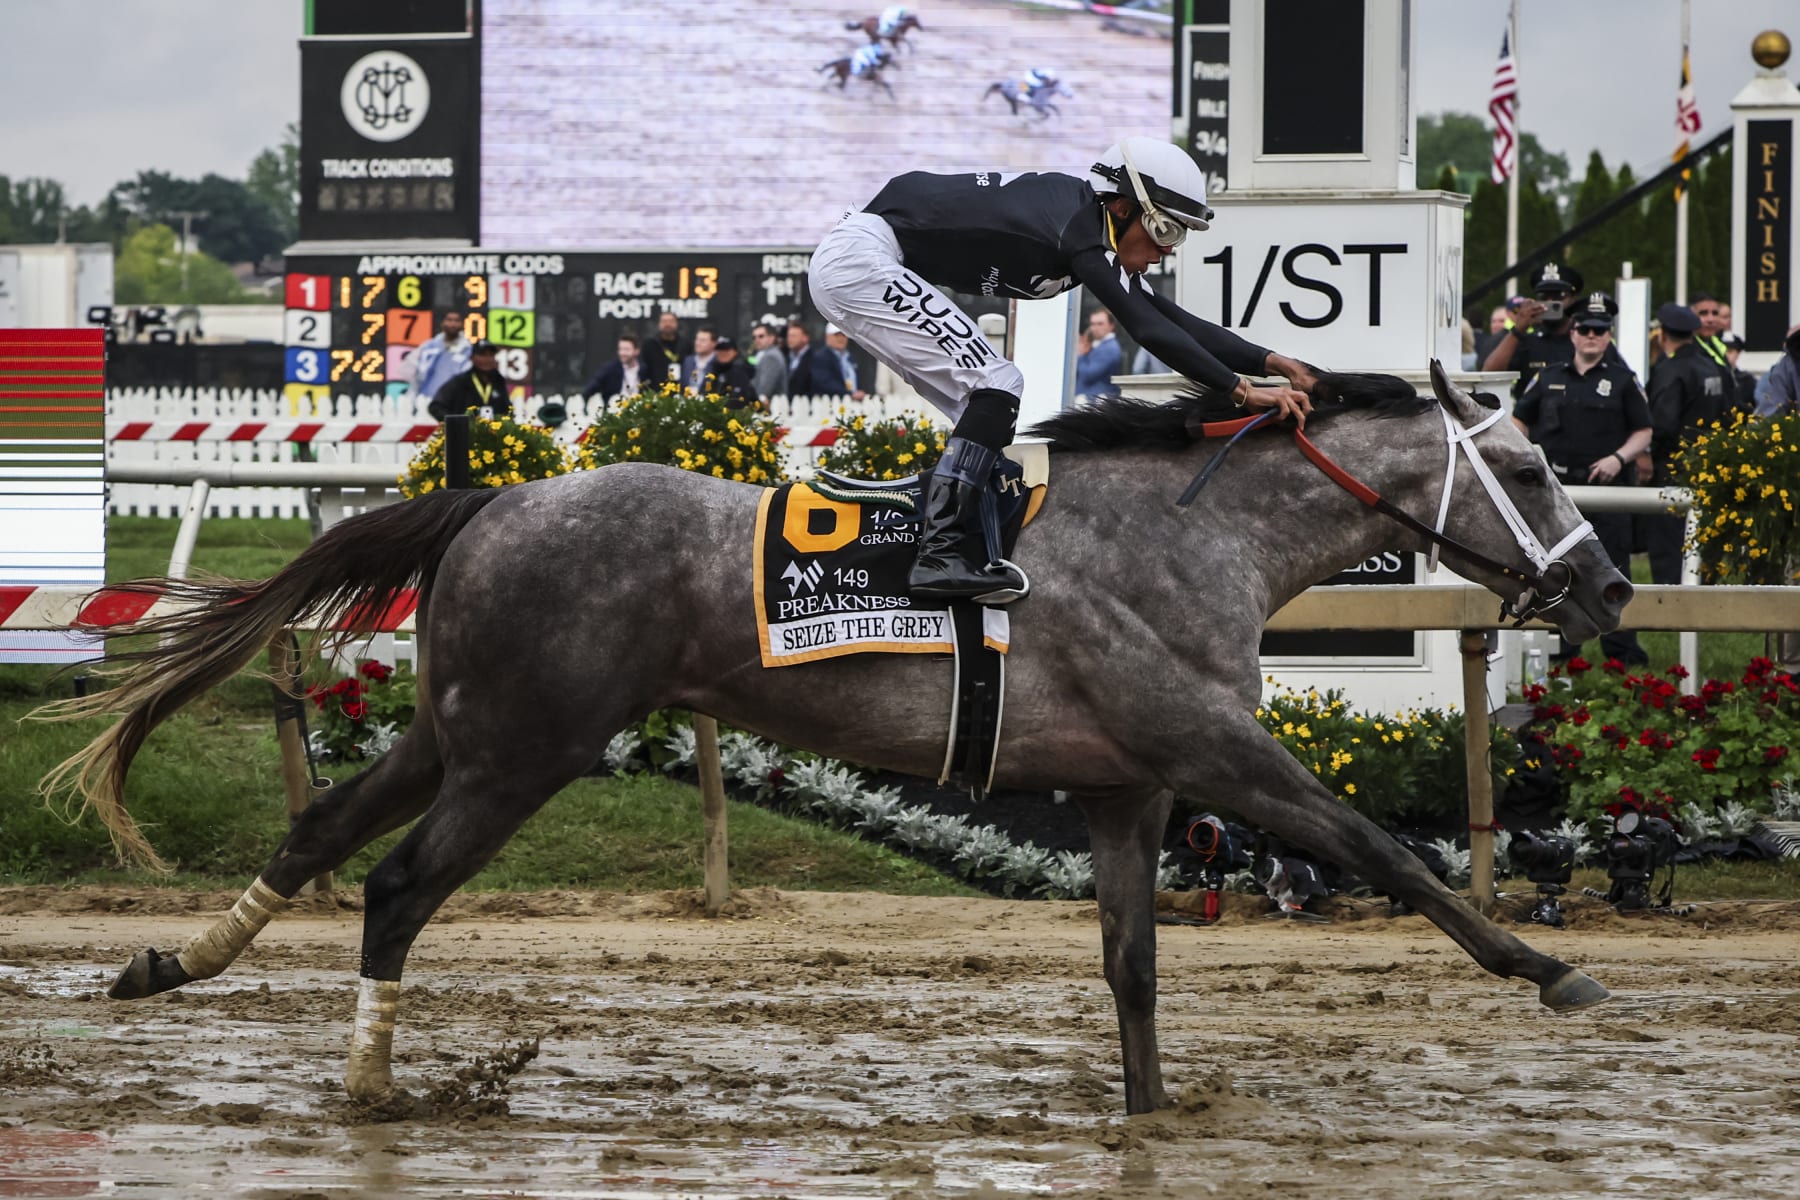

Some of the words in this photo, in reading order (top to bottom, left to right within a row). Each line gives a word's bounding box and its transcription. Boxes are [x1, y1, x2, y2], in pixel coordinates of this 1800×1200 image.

[1196, 130, 1227, 157] 3/4
[321, 158, 369, 178] TRACK
[368, 157, 454, 178] CONDITIONS
[1757, 142, 1780, 302] FINISH
[357, 256, 500, 275] APPROXIMATE
[504, 254, 565, 275] ODDS
[300, 277, 316, 308] 1
[397, 275, 421, 308] 6
[464, 275, 487, 308] 9
[498, 279, 526, 305] 11
[594, 272, 664, 296] RACE
[678, 266, 719, 299] 13
[761, 276, 794, 306] 1st
[1203, 243, 1408, 329] 1/ST
[599, 299, 652, 319] POST
[657, 298, 708, 319] TIME
[299, 315, 317, 342] 2
[362, 313, 385, 345] 7
[400, 314, 420, 341] 7
[495, 315, 527, 341] 12
[882, 285, 978, 369] WIPES
[295, 350, 319, 382] 3
[494, 348, 529, 381] 13
[860, 532, 915, 545] GRAND
[833, 569, 869, 588] 149
[776, 593, 911, 619] PREAKNESS
[783, 623, 837, 650] SEIZE
[842, 616, 886, 640] THE
[891, 616, 944, 639] GREY
